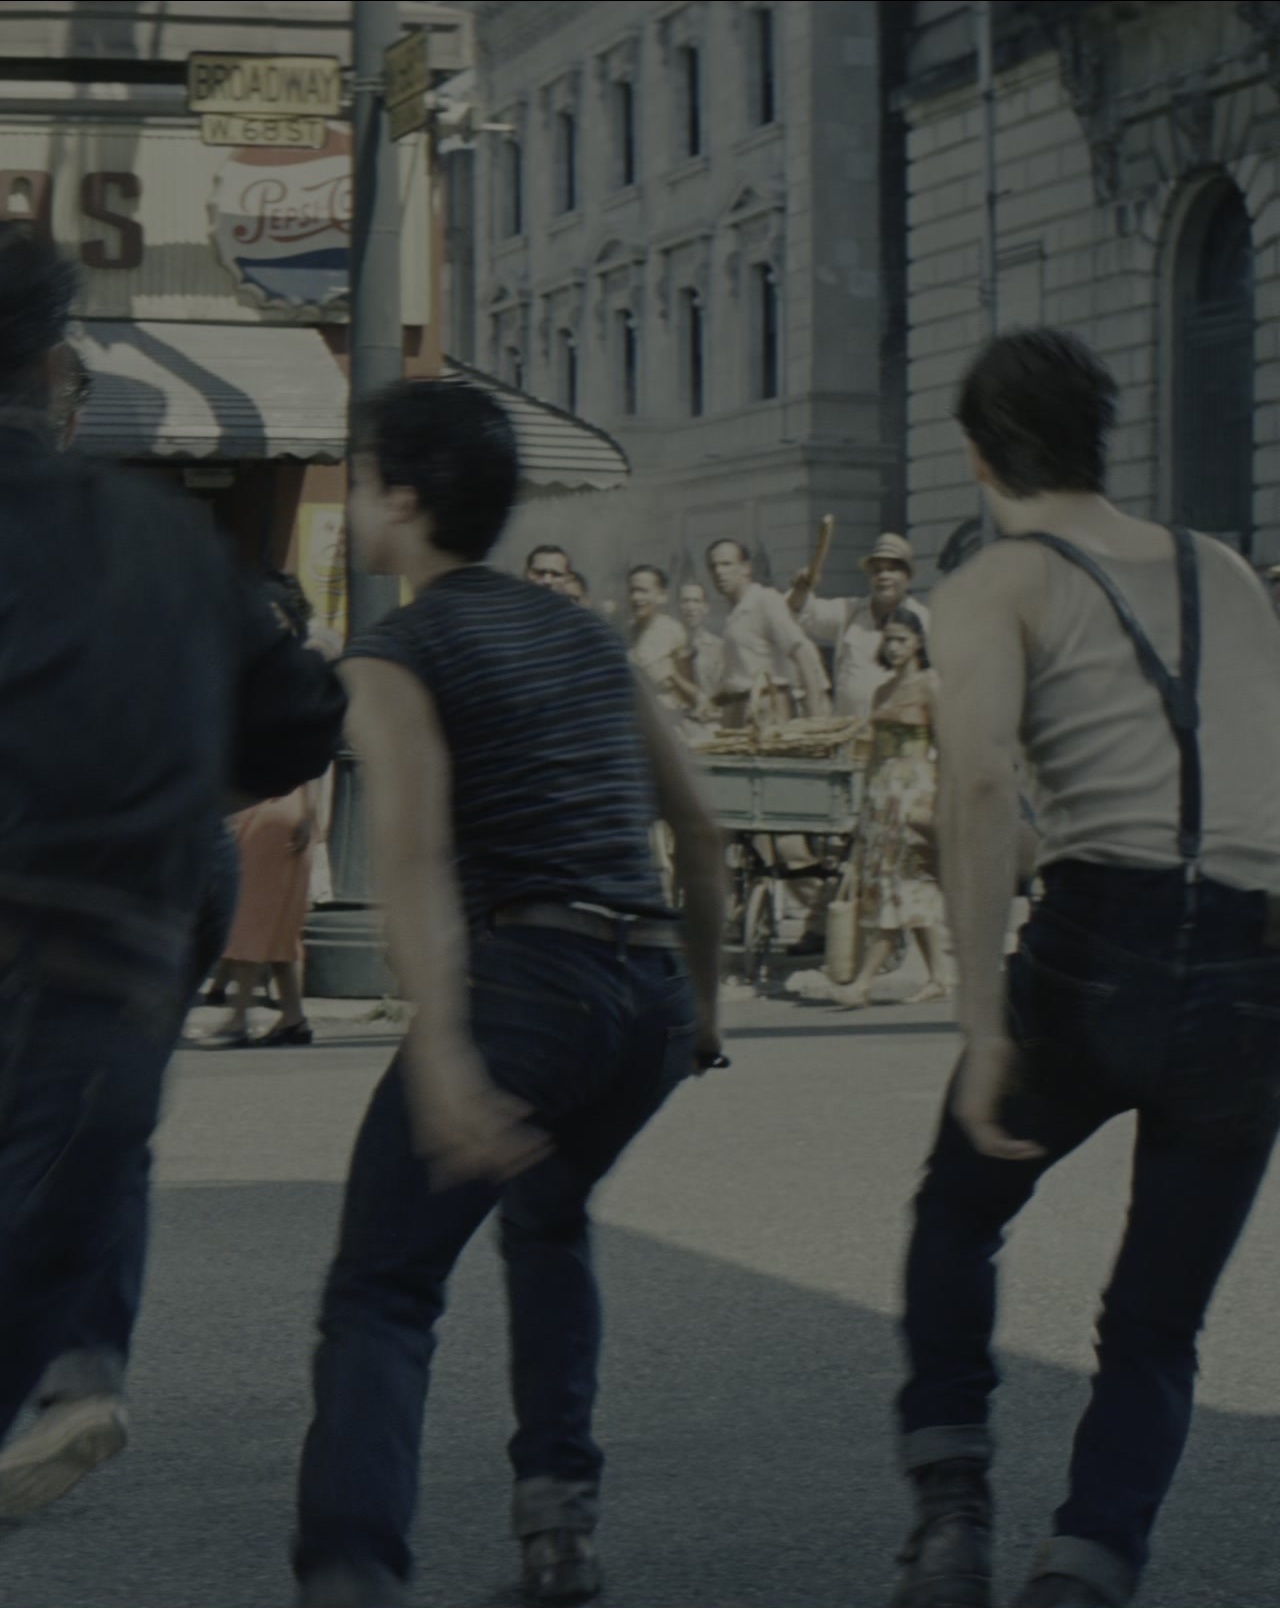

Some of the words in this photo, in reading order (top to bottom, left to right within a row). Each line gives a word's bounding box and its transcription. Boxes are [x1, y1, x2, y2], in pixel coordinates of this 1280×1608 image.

[195, 64, 336, 102] BROADWAY
[209, 119, 229, 138] W
[287, 119, 320, 141] ST
